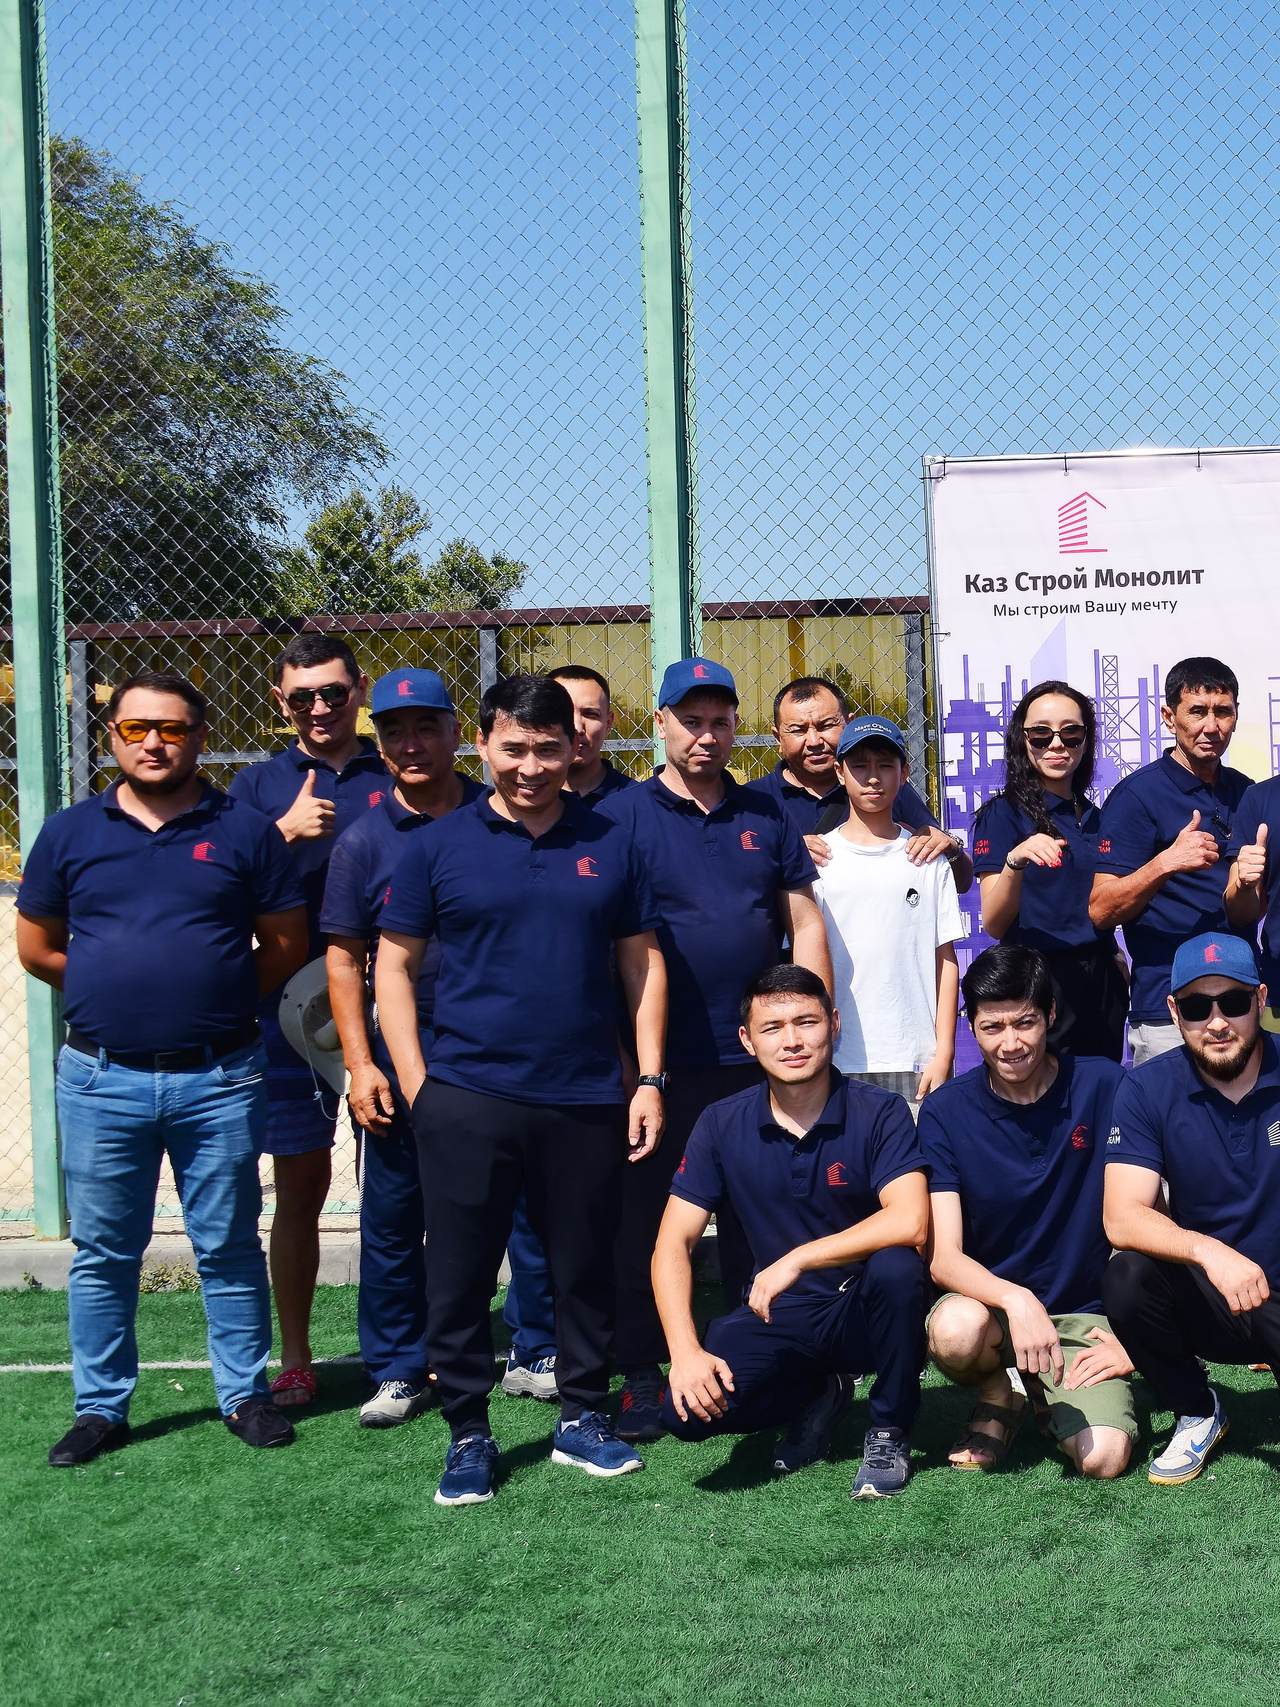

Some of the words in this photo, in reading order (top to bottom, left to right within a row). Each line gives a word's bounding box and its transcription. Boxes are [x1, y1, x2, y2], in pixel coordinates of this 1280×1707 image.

[965, 573, 1009, 594] Каз
[1014, 566, 1088, 596] Строй
[1094, 568, 1205, 589] Монолит
[993, 603, 1020, 617] Мы
[1023, 603, 1081, 619] строим
[1085, 600, 1127, 616] Вашу
[1131, 600, 1178, 614] мечту
